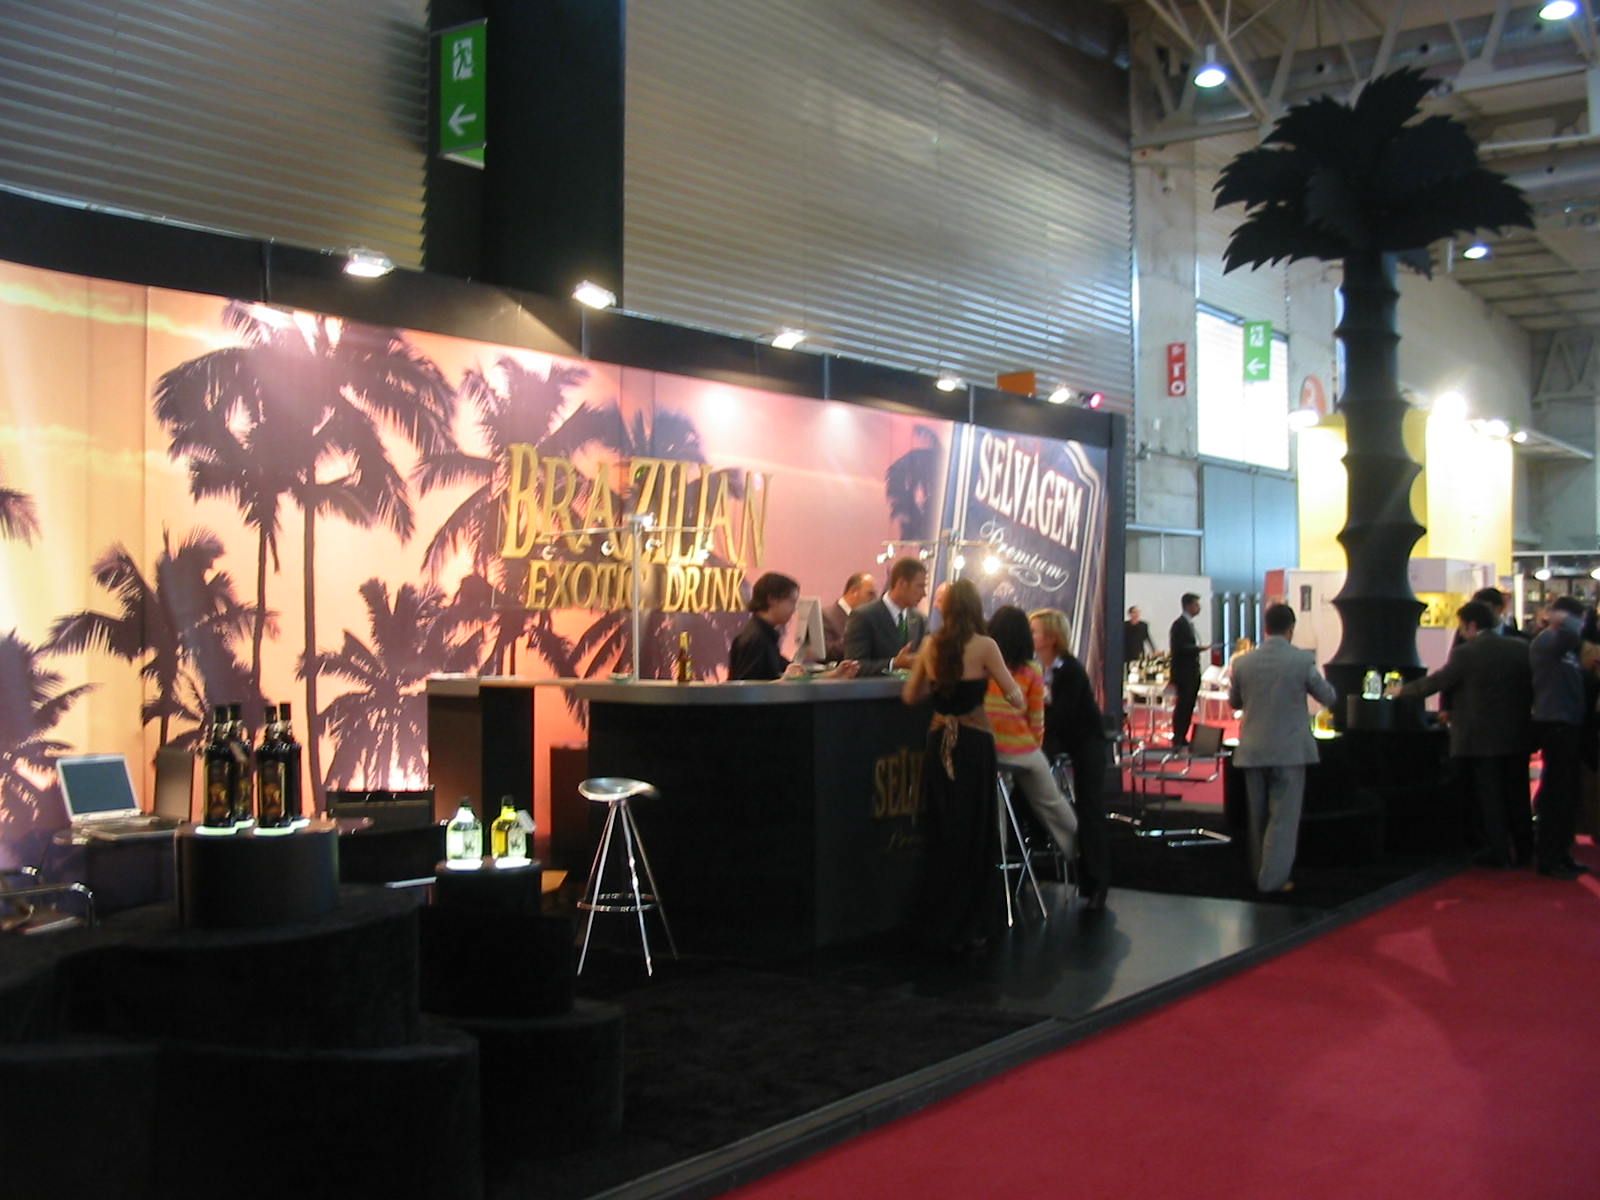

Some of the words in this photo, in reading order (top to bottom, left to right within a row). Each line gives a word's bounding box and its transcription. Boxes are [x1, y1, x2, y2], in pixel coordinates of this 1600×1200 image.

[501, 442, 772, 568] BRAZILIAN
[975, 432, 1083, 552] SELVAGEM
[661, 563, 748, 614] DRINK
[979, 517, 1069, 592] Premium
